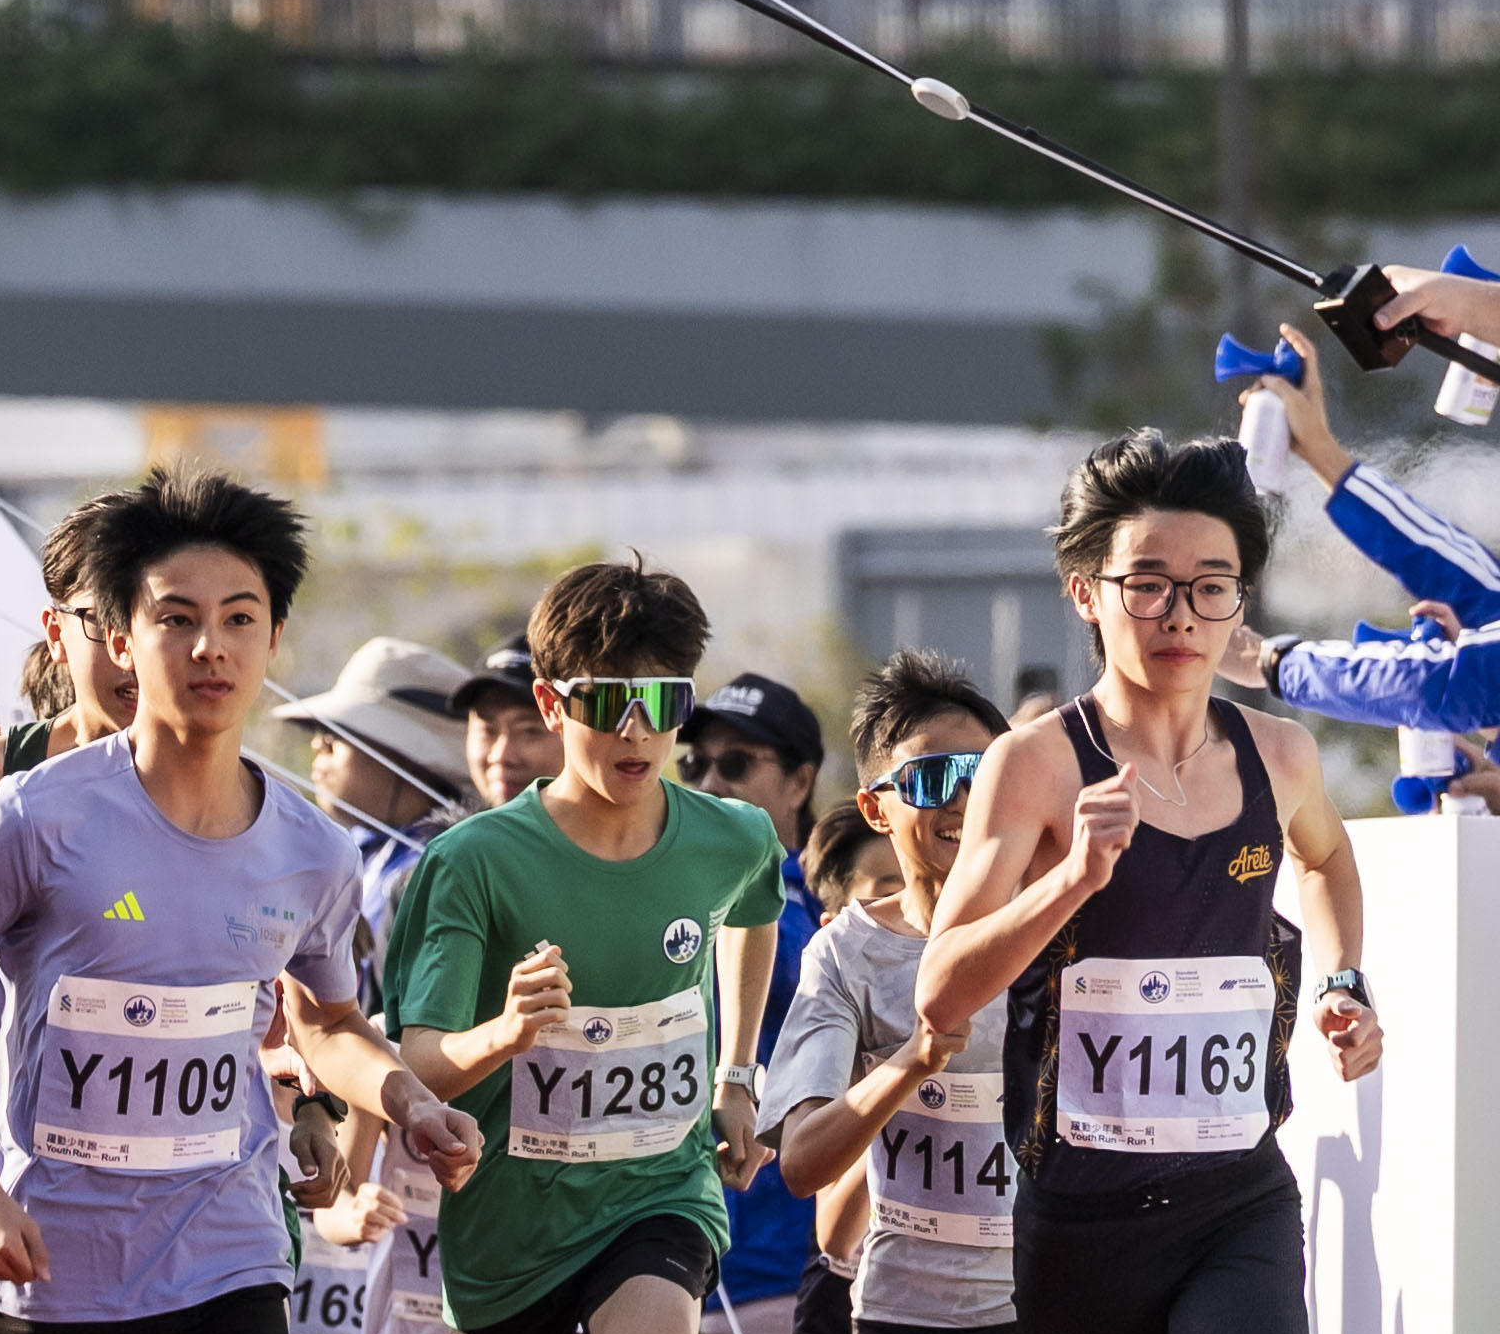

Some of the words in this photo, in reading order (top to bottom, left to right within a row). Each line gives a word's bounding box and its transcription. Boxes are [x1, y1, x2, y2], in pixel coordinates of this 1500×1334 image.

[1077, 1031, 1257, 1096] Y1163
[59, 1048, 237, 1116] Y1109
[526, 1053, 699, 1118] Y1283
[1070, 1132, 1098, 1143] Youth
[1099, 1134, 1117, 1144] Run
[1127, 1137, 1147, 1146] Run
[1150, 1137, 1155, 1146] 1
[45, 1144, 72, 1158] Youth
[72, 1147, 91, 1160] Run
[101, 1150, 120, 1163] Run
[123, 1151, 129, 1163] 1
[521, 1144, 545, 1156] Youth
[572, 1148, 589, 1158] Run
[914, 1223, 931, 1234] Run
